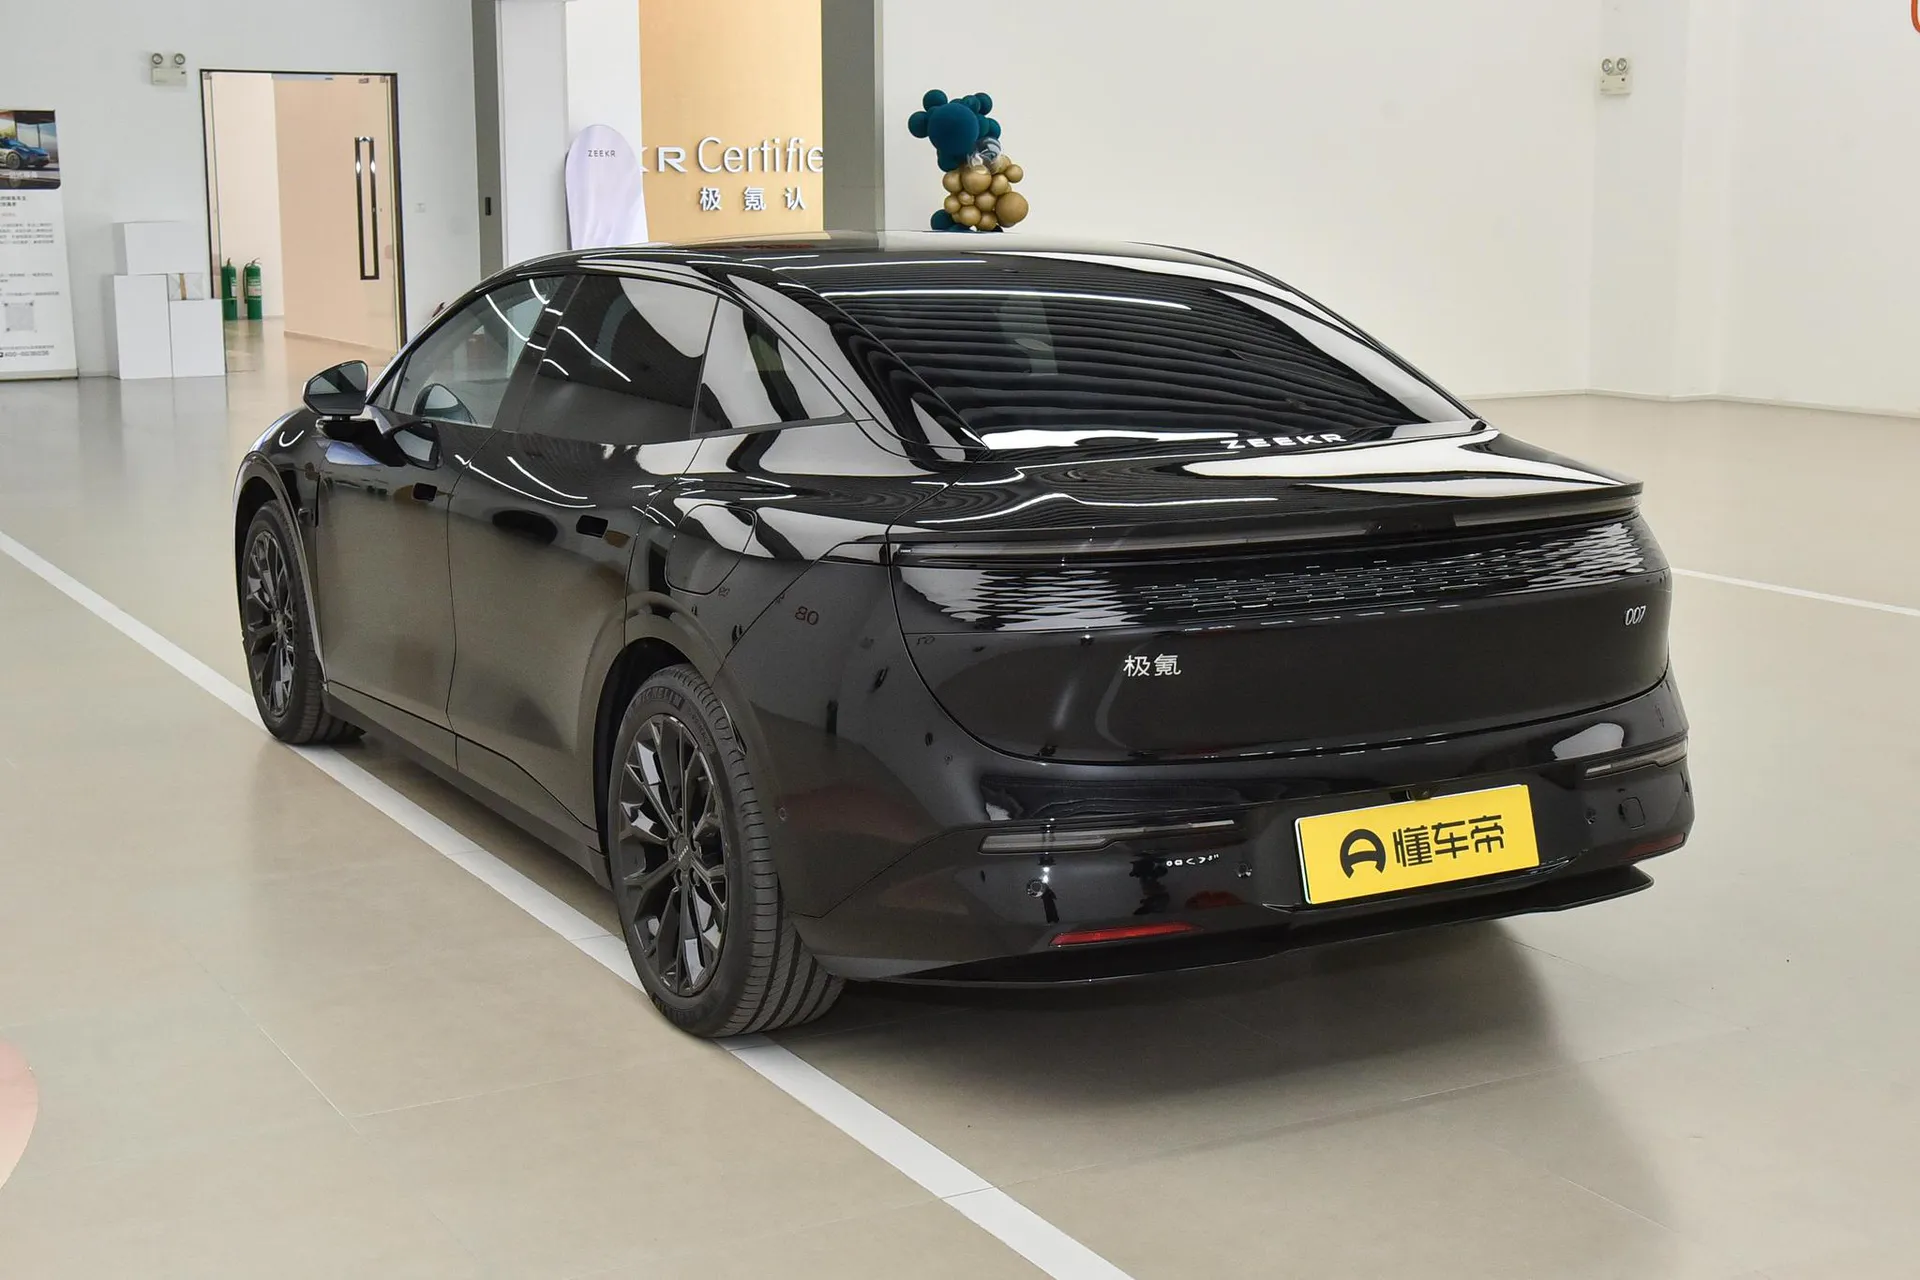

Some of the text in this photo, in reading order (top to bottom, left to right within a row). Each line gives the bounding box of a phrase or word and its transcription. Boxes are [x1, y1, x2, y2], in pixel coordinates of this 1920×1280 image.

[588, 149, 616, 158] ZEEKR
[699, 186, 806, 211] 极氪认
[1220, 433, 1347, 449] ZEEKR
[1625, 605, 1646, 626] 007
[1123, 653, 1181, 677] 极氪
[1392, 815, 1505, 867] 懂车帝
